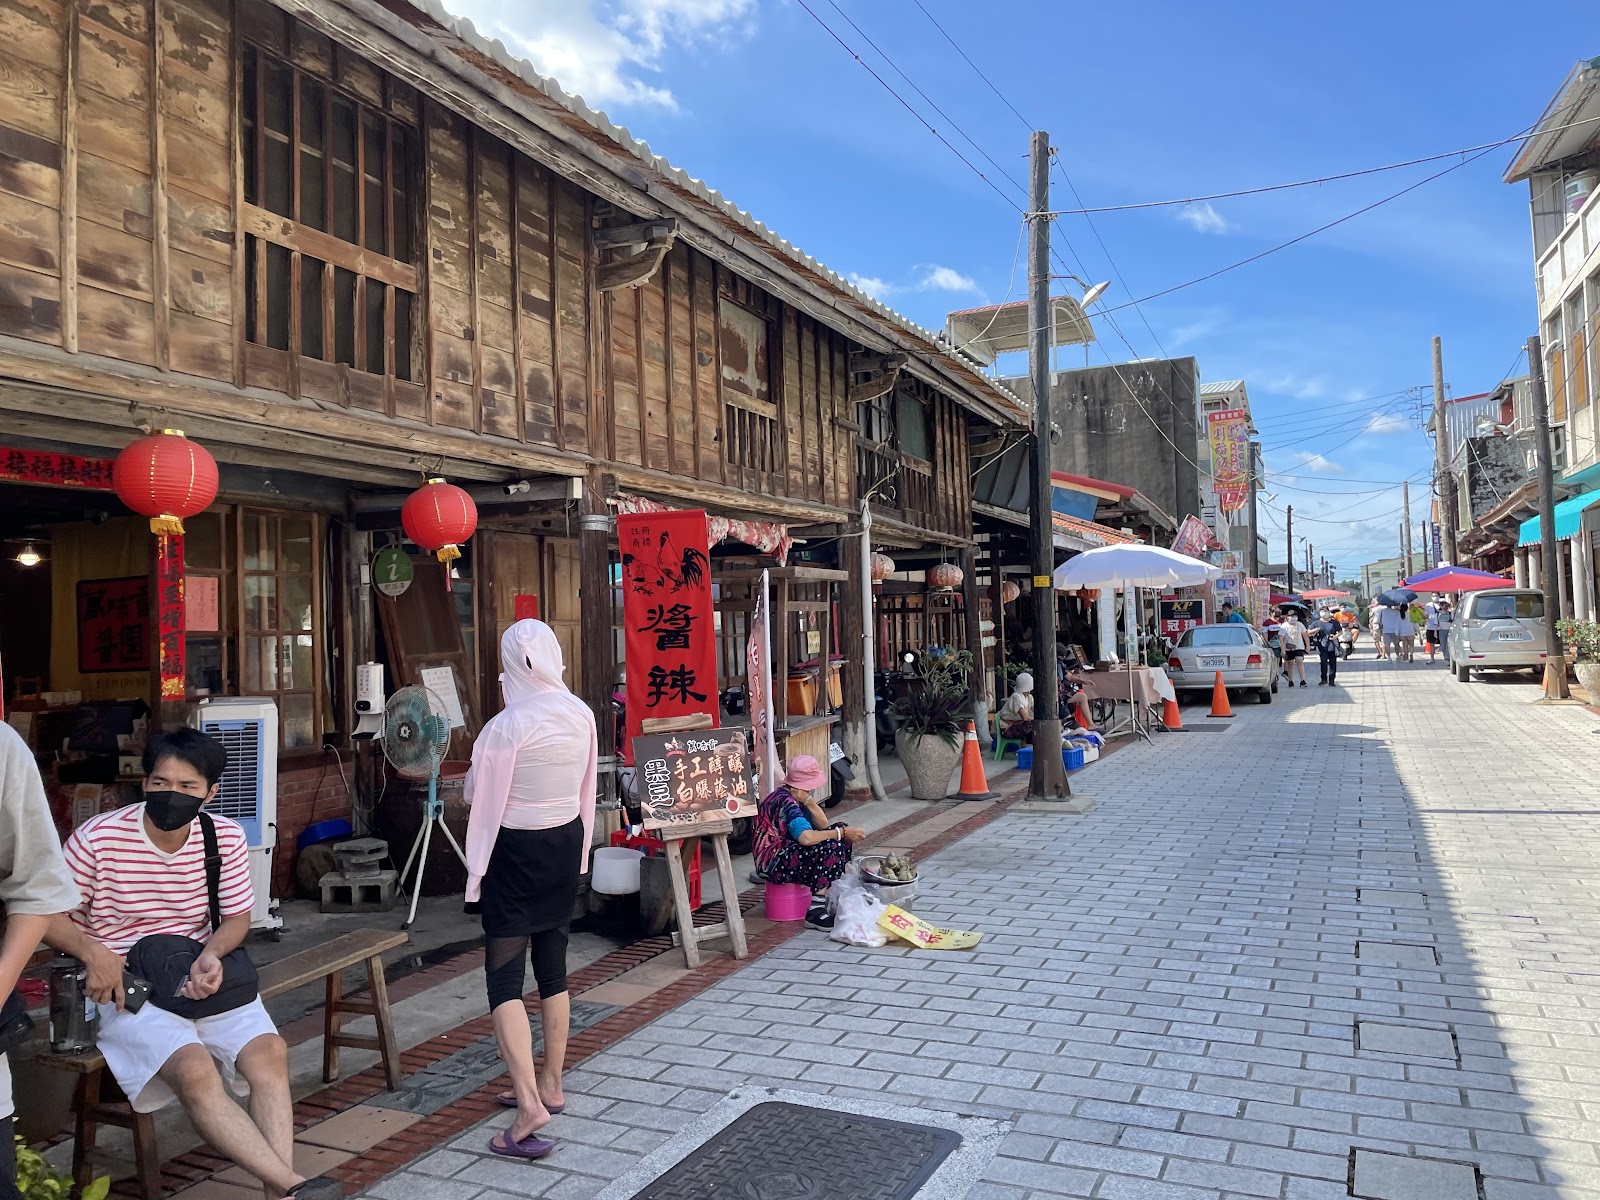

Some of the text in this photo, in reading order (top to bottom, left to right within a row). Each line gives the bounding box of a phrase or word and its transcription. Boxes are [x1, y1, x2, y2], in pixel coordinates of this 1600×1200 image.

[630, 526, 650, 535] 註冊
[632, 537, 652, 547] 商標
[1172, 602, 1193, 610] KP
[674, 753, 744, 779] 手工醇釀
[644, 759, 674, 807] 黑豆
[676, 775, 747, 803] 白曝蔭油
